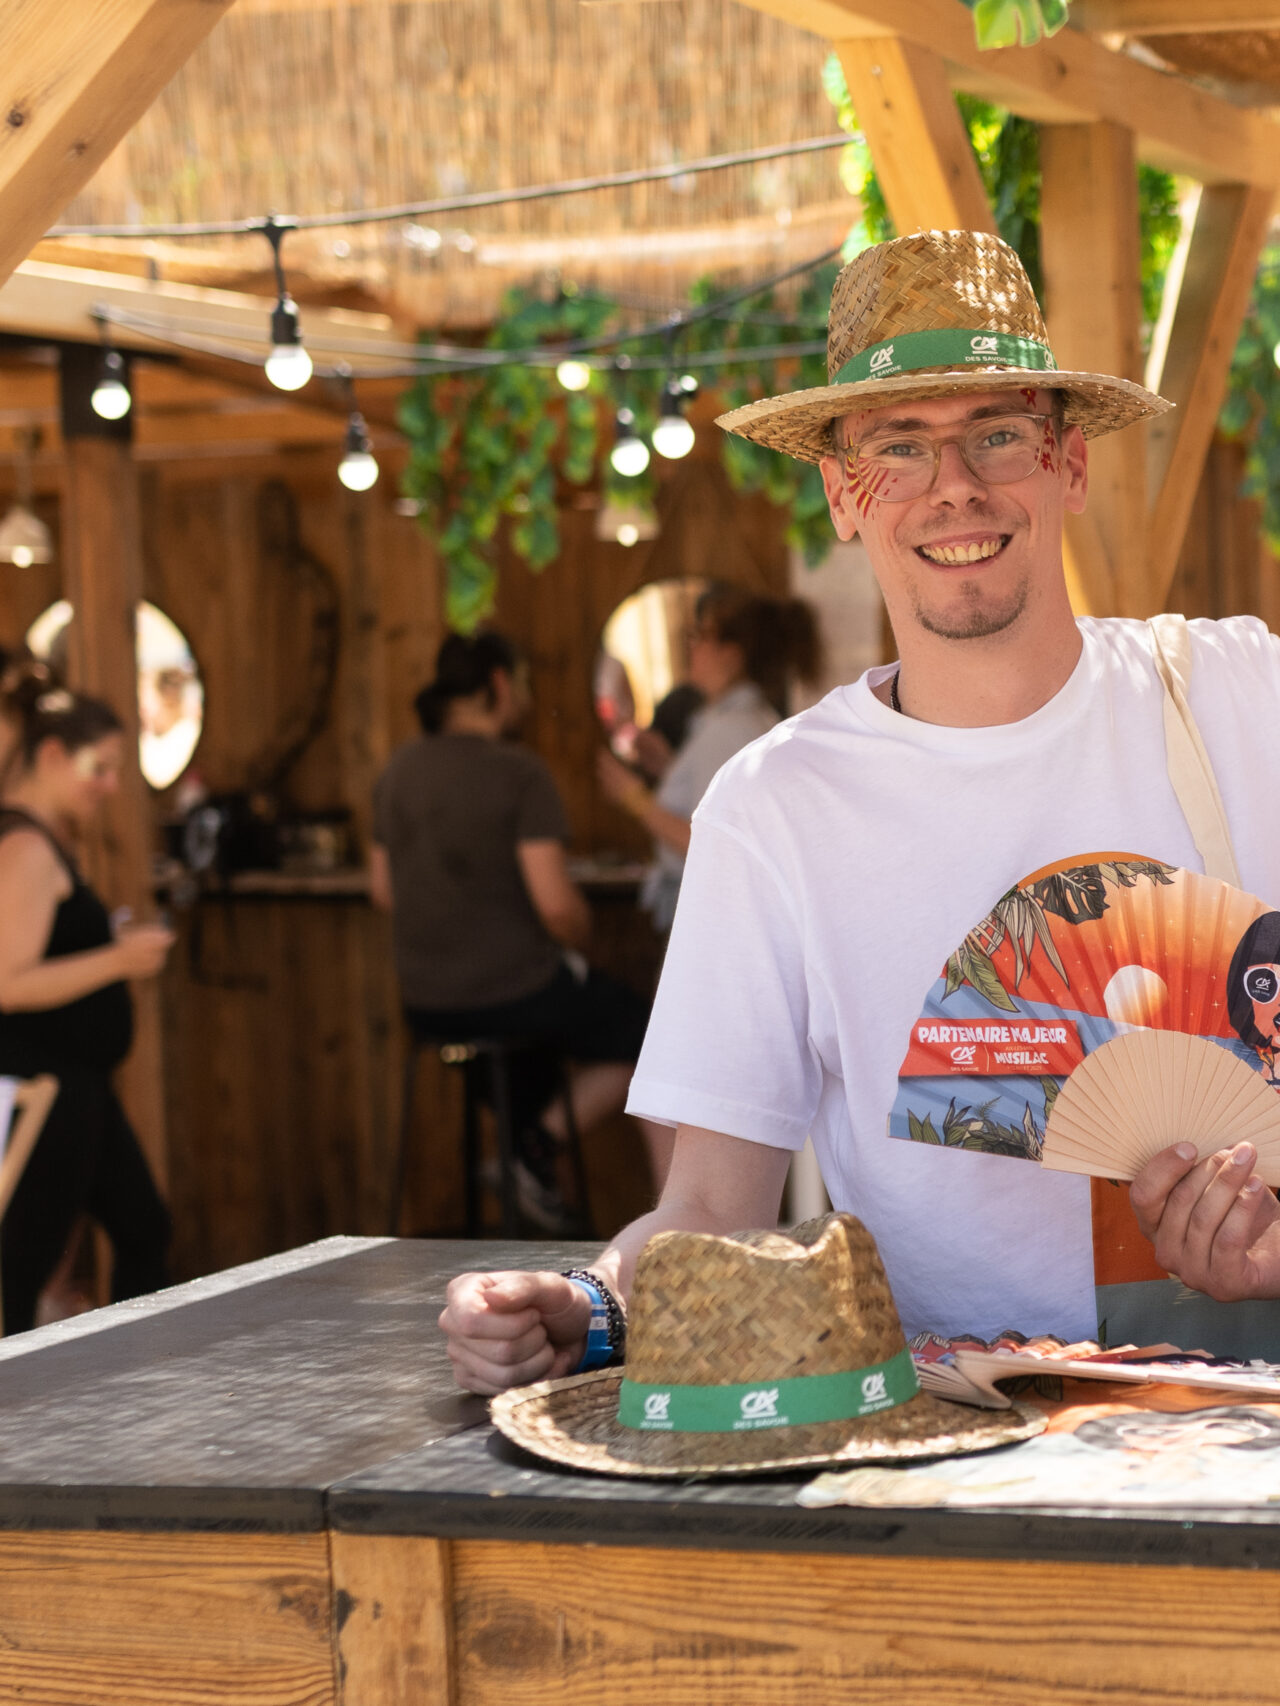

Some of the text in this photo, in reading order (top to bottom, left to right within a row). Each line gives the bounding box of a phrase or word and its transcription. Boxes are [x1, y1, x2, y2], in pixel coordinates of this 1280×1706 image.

[877, 365, 902, 377] SAVOIE
[918, 1026, 1067, 1044] PARTENAIRE MAJEUR
[994, 1051, 1049, 1064] MUSILAC
